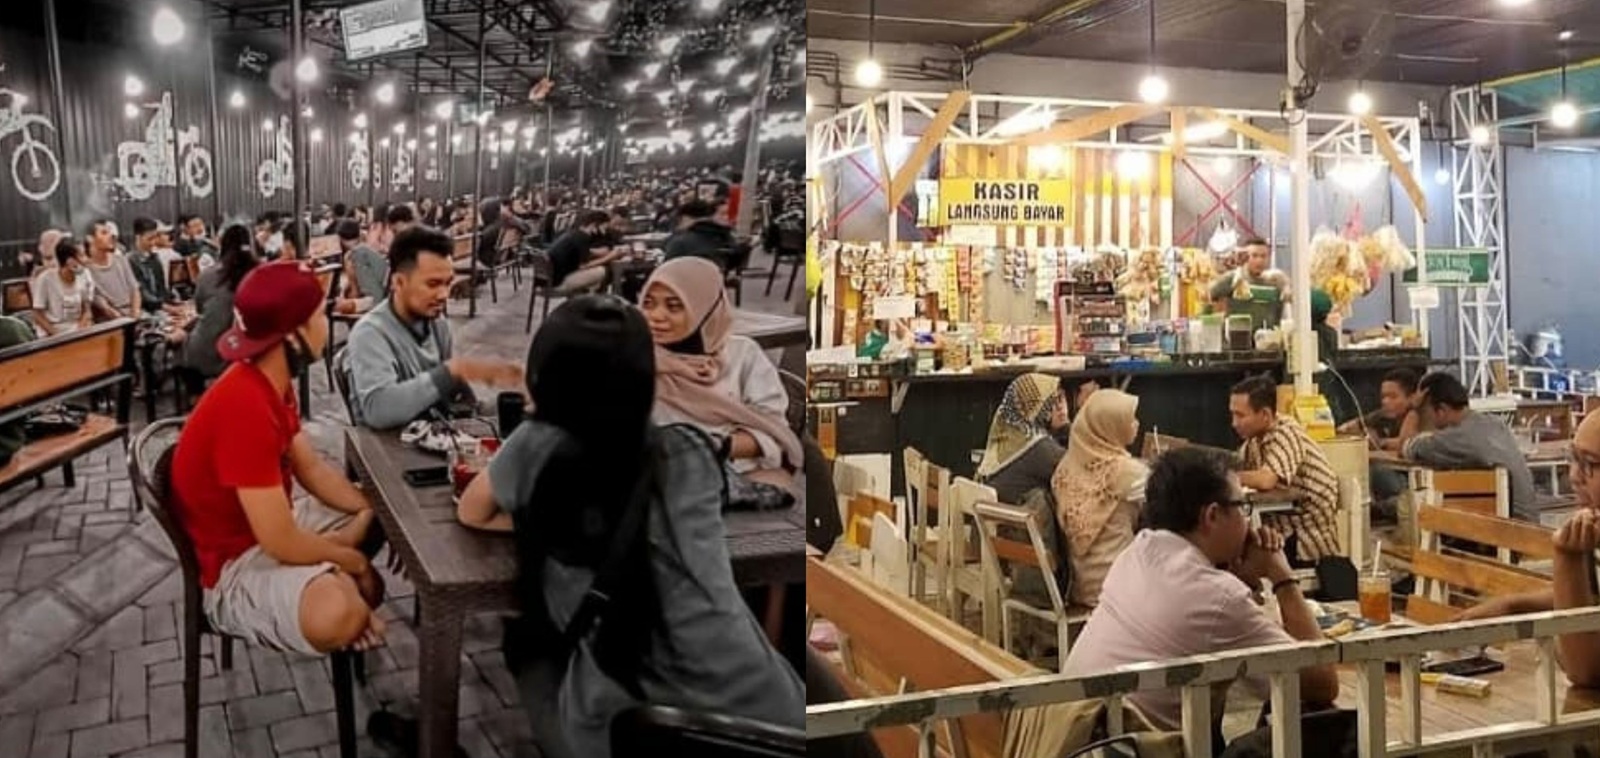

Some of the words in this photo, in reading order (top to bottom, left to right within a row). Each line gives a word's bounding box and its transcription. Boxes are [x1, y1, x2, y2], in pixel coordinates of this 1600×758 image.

[974, 182, 1040, 200] KASIR
[948, 204, 1019, 220] LANGSUNG
[1024, 205, 1065, 221] BAYAR
